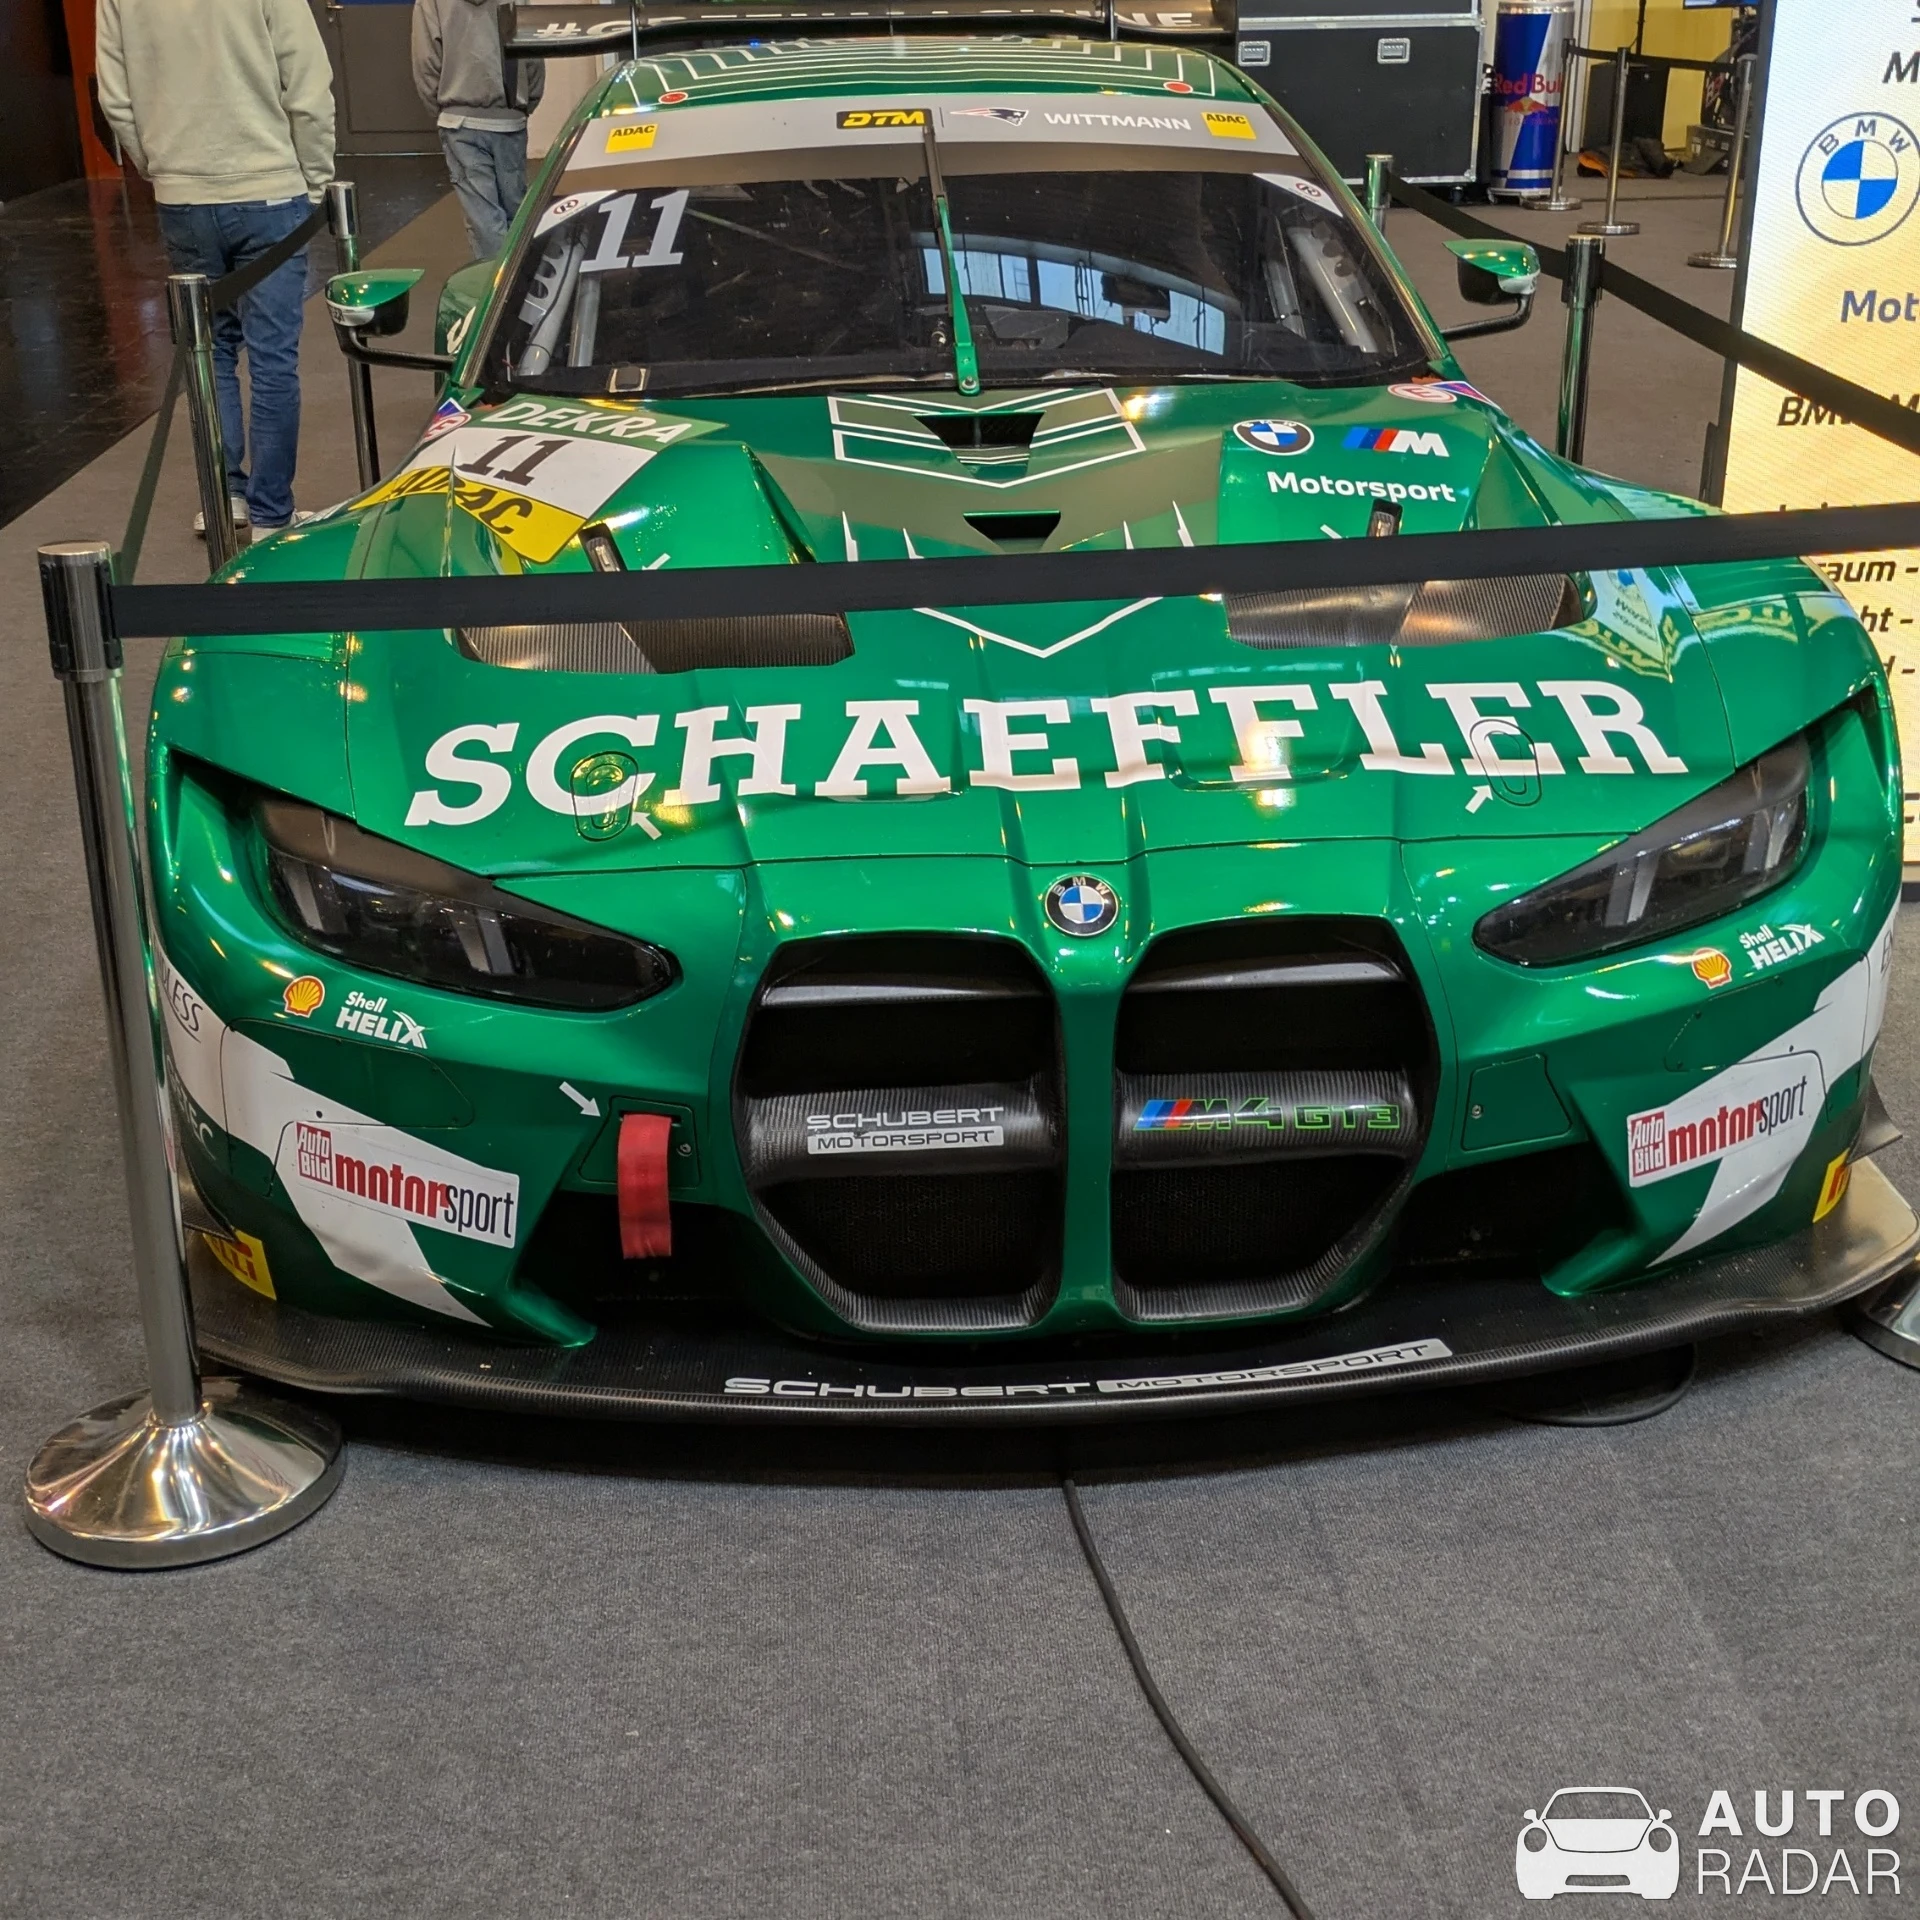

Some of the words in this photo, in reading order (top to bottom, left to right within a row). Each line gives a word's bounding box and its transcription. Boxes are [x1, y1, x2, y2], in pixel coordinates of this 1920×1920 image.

[612, 125, 655, 137] ADAC
[842, 111, 925, 127] DTM
[1044, 113, 1192, 131] WITTMANN
[1206, 113, 1247, 125] ADAC
[579, 190, 689, 273] 11
[481, 402, 692, 443] DEKRA
[1777, 396, 1852, 426] BM
[455, 435, 573, 486] 11
[1267, 471, 1457, 503] Motorsport
[404, 680, 1689, 827] SCHAEFFLER
[1739, 924, 1775, 949] Shell
[1746, 923, 1826, 971] HELIX
[345, 991, 388, 1013] Shell
[335, 1006, 428, 1050] HELIX
[807, 1107, 1004, 1130] SCHUBERT
[1293, 1104, 1400, 1129] GT3
[298, 1126, 331, 1159] Auto
[817, 1130, 995, 1151] MOTORSPORT
[1631, 1116, 1664, 1150] Auto
[301, 1152, 332, 1182] Bild
[1635, 1142, 1665, 1175] Bild
[724, 1378, 1091, 1397] SCHUBERT
[1116, 1344, 1429, 1389] MOTORSPORT
